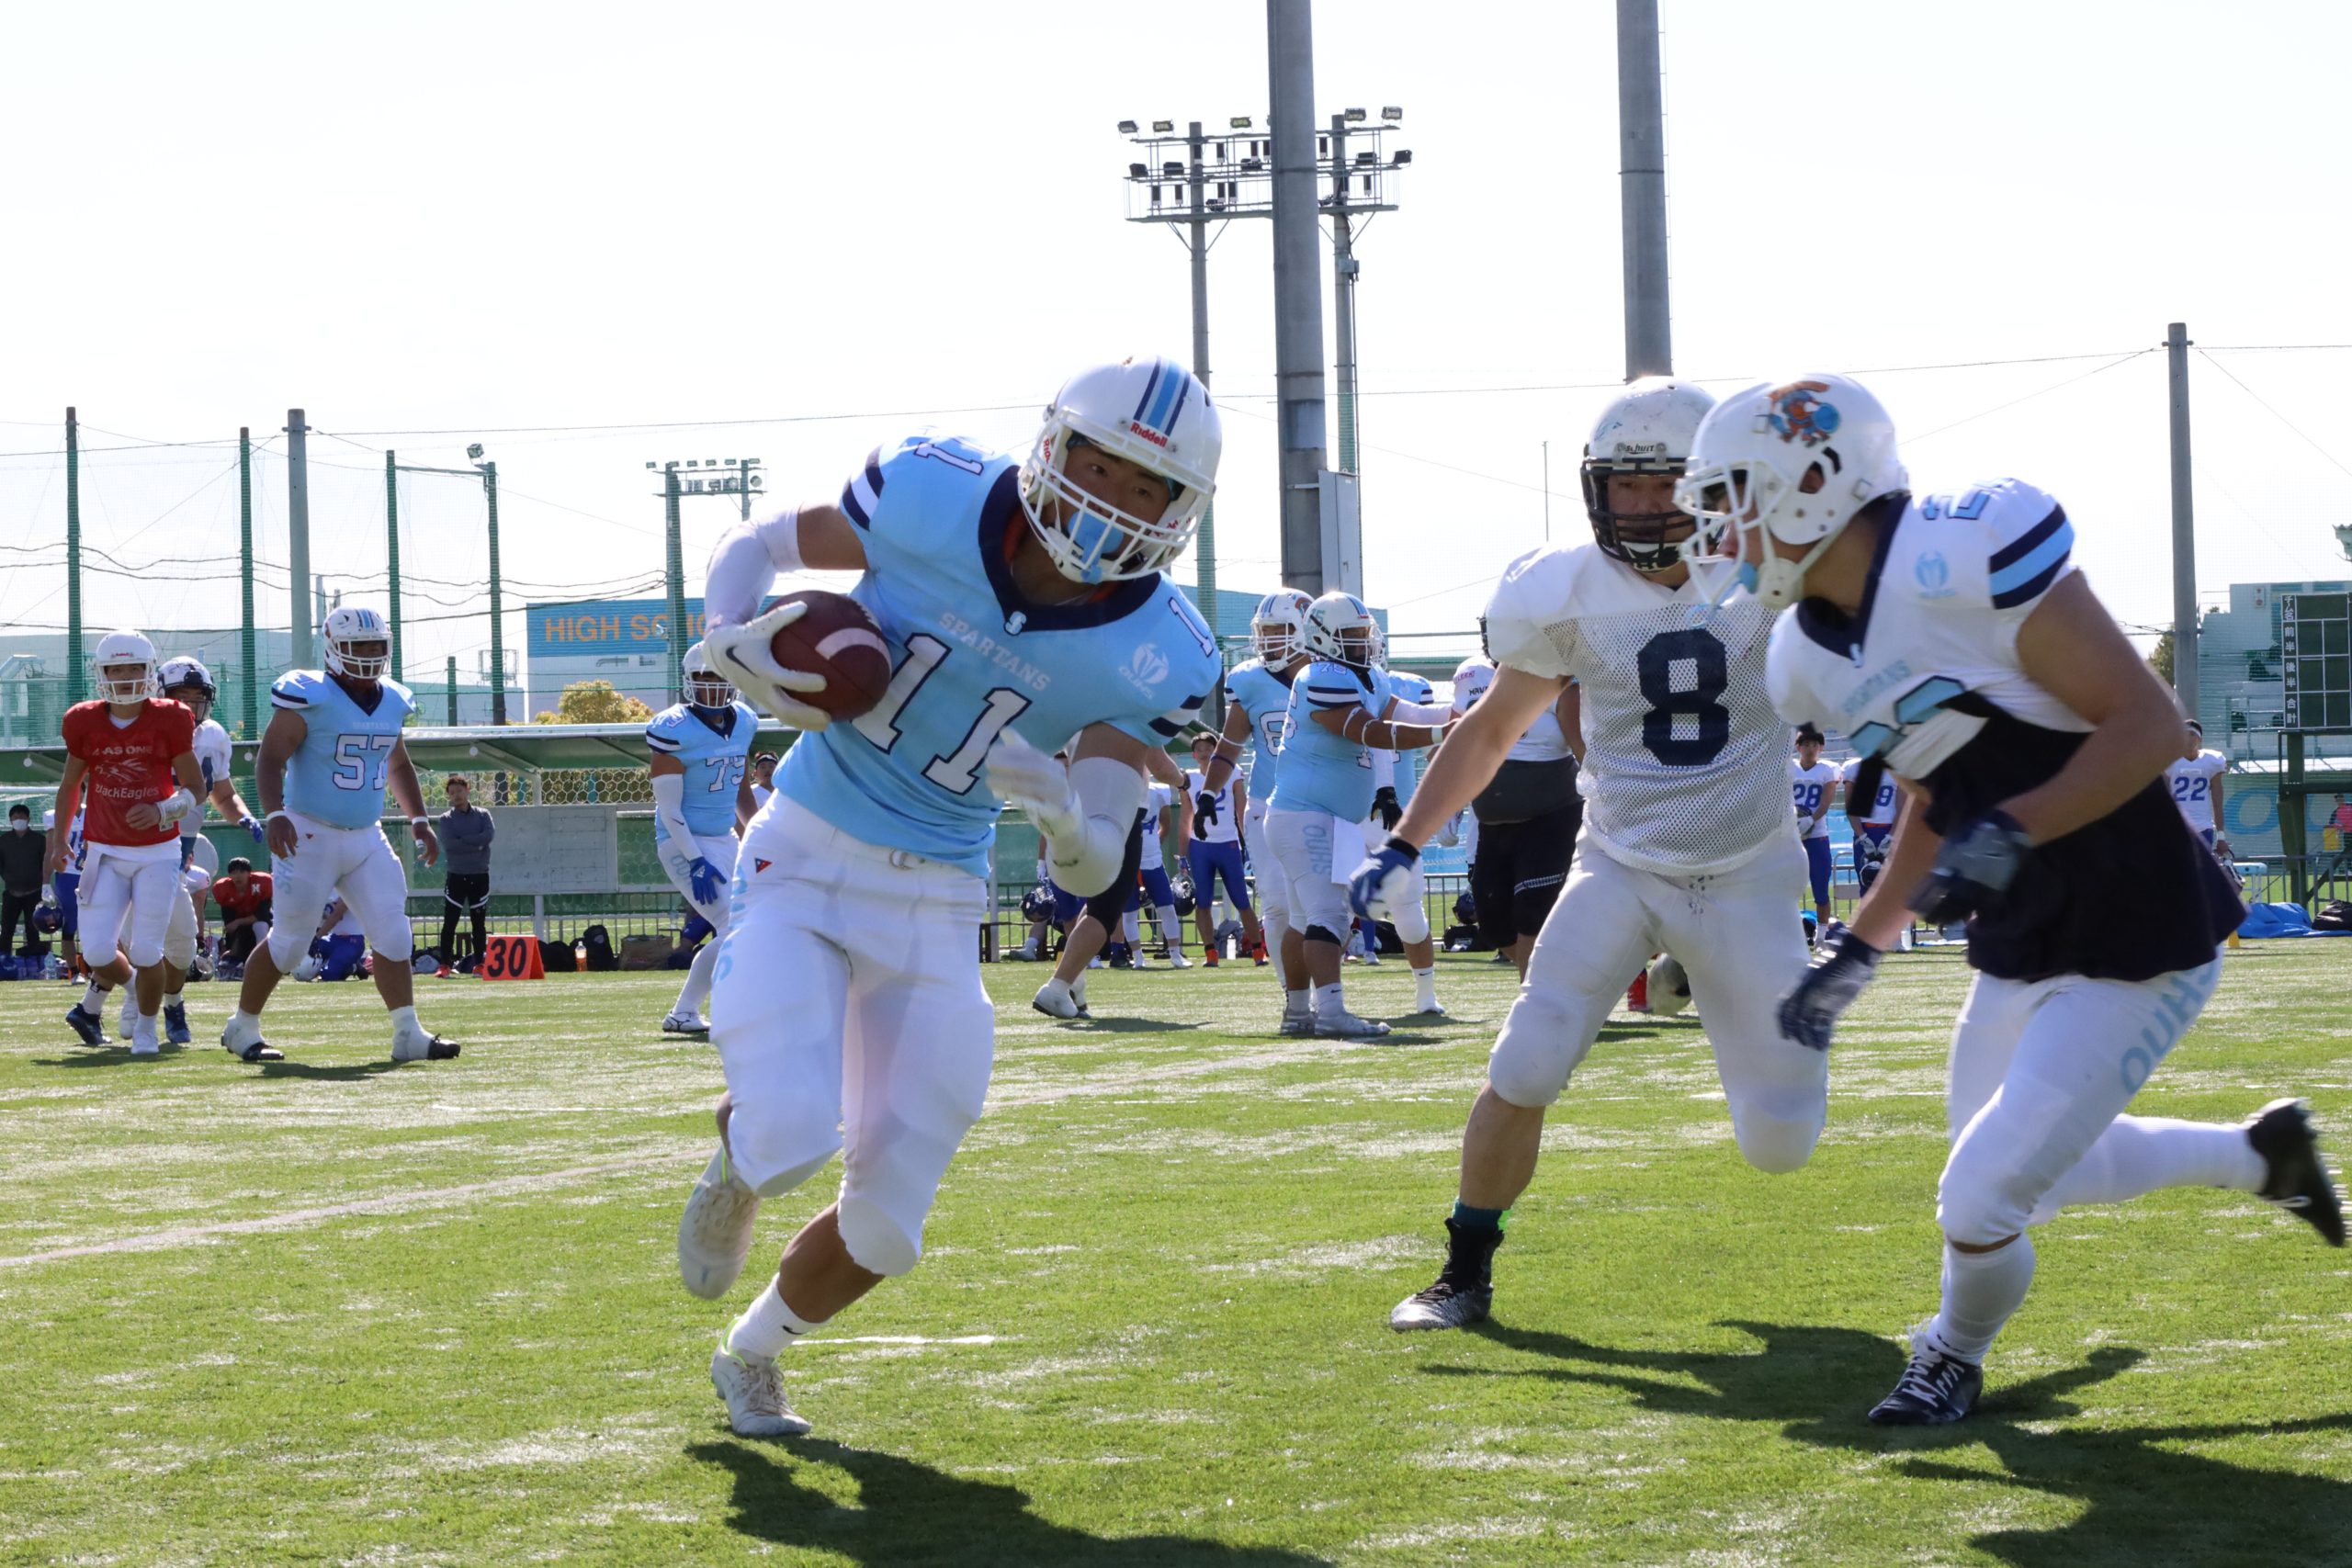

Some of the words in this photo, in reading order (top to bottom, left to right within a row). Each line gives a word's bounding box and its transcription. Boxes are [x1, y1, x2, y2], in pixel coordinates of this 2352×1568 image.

[1130, 422, 1170, 448] Riddell
[545, 615, 620, 642] HIGH
[939, 611, 1052, 692] SPARTANS
[851, 633, 1033, 796] 11
[1637, 628, 1729, 766] 8
[2287, 698, 2297, 724] 合計
[333, 734, 398, 791] 57
[1793, 784, 1823, 808] 28
[2174, 776, 2208, 802] 22
[1302, 824, 1332, 876] OUHS
[487, 938, 527, 978] 30
